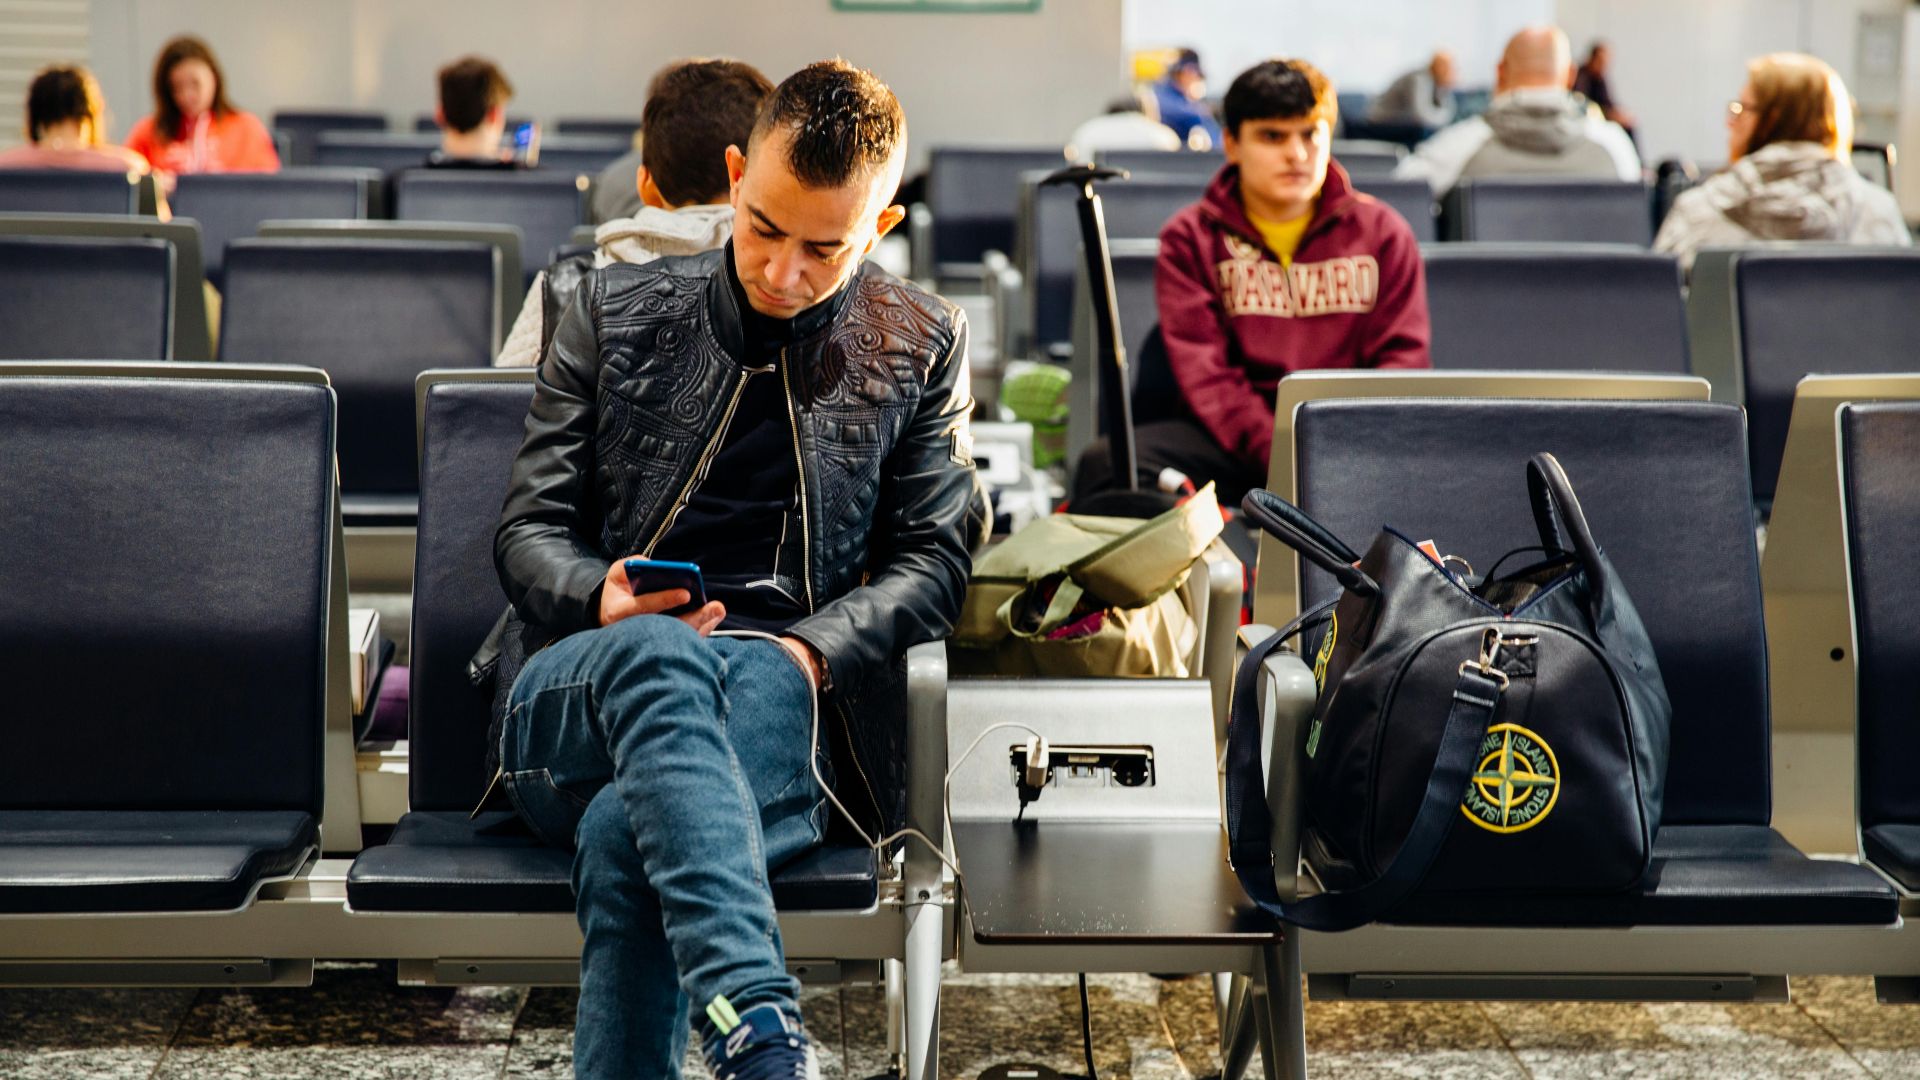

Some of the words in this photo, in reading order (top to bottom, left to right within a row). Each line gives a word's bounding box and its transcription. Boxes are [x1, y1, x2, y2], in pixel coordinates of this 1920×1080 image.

[1216, 255, 1379, 318] HARVARD
[1511, 734, 1551, 777] ISLAND
[1509, 786, 1550, 825] STONE
